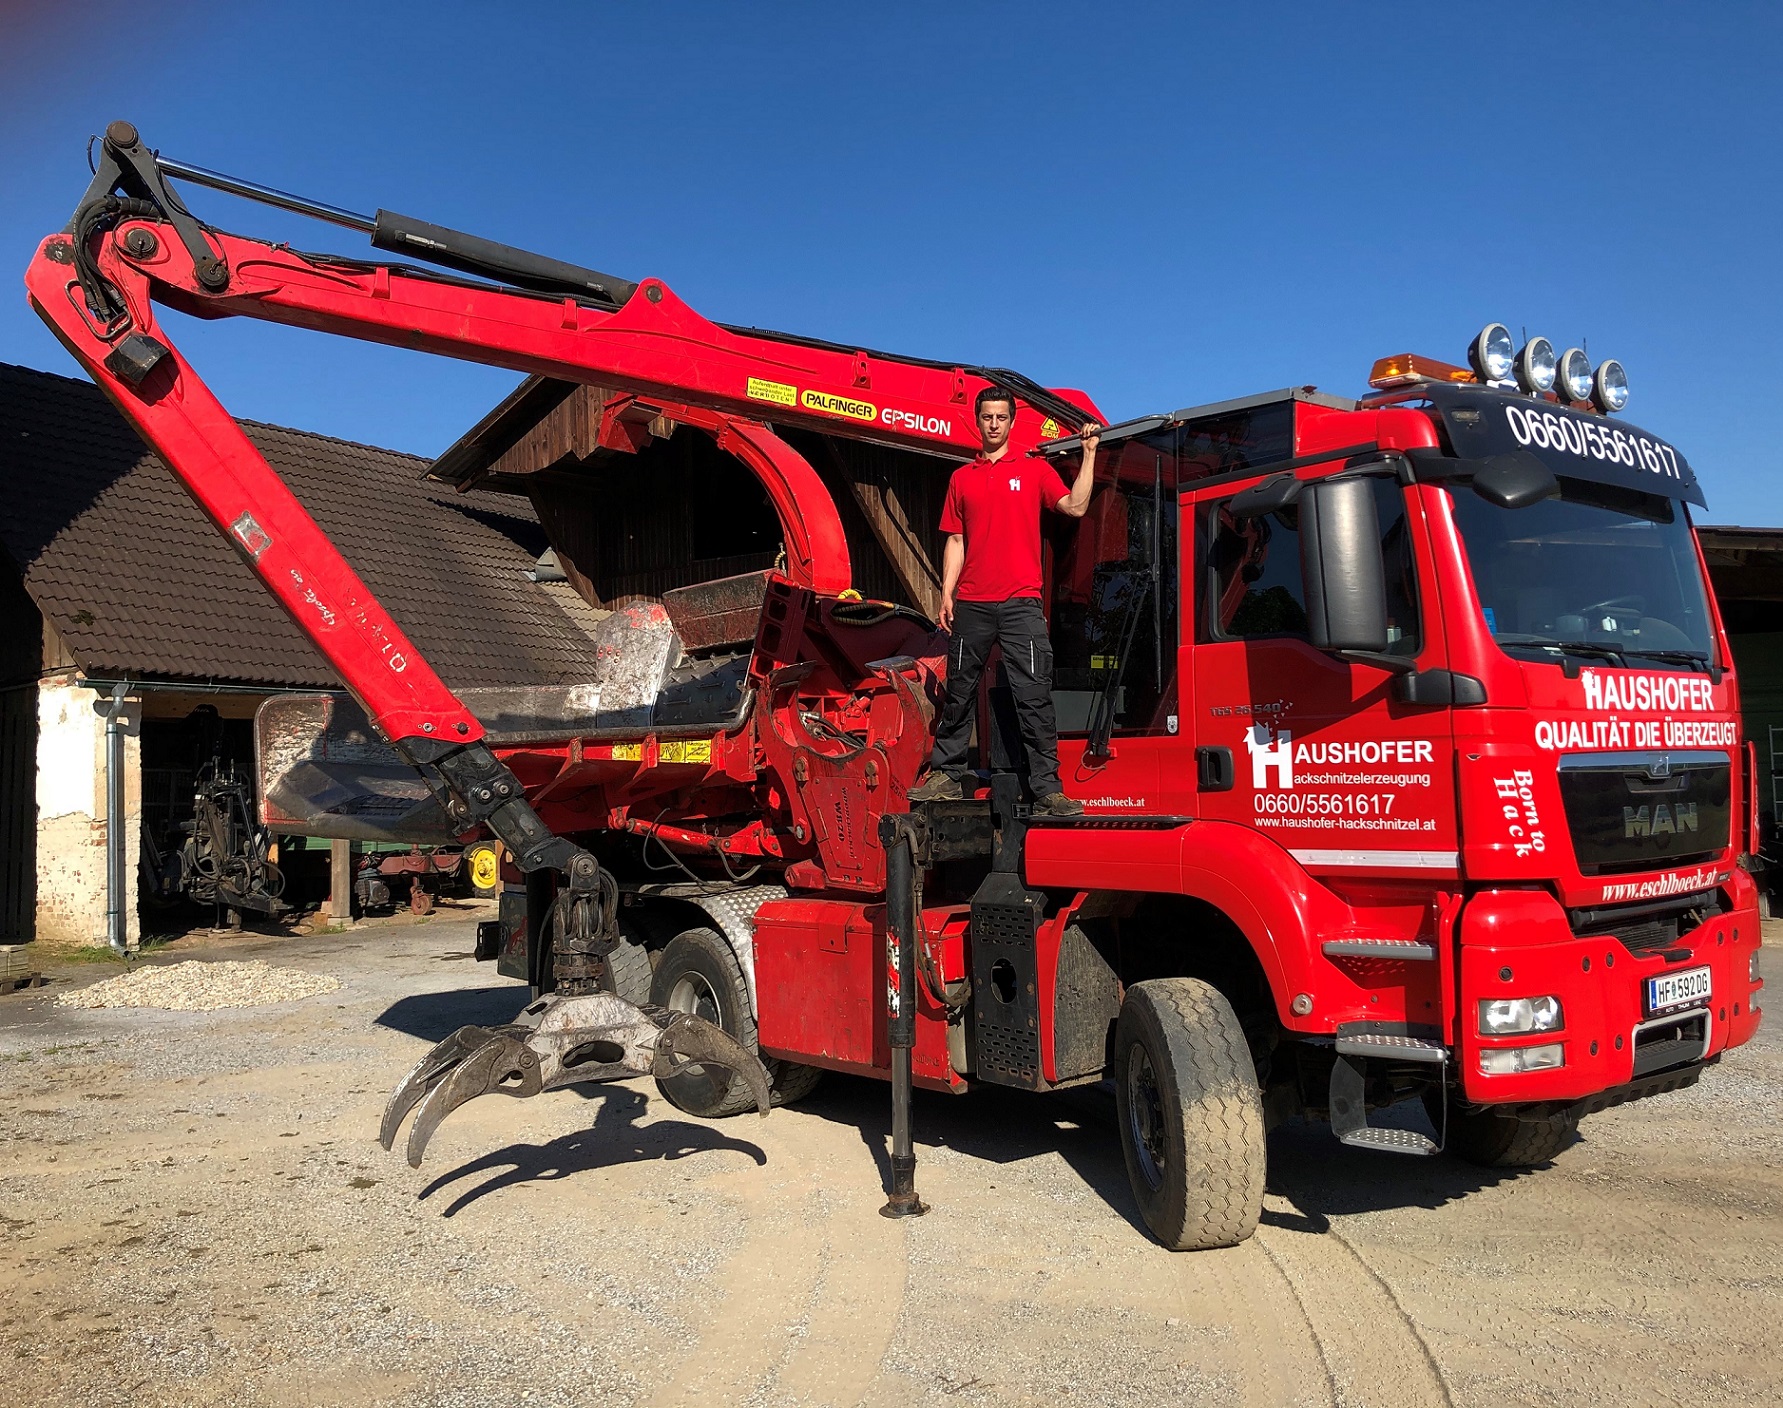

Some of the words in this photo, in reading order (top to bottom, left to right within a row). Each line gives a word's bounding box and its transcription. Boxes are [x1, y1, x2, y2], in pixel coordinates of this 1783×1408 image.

[806, 393, 873, 417] PALFINGER
[881, 408, 951, 436] EPSILON
[1505, 406, 1681, 479] 0660/5561617
[1582, 669, 1714, 711] HAUSHOFER
[1210, 706, 1232, 716] TGS
[1534, 716, 1631, 750] QUALITÄT
[1634, 721, 1661, 747] DIE
[1664, 715, 1737, 746] ÜBERZEUGT
[1294, 771, 1431, 787] ackschnitzelerzeugung
[1253, 793, 1396, 815] 0660/5561617
[1513, 769, 1540, 826] Born
[1530, 830, 1546, 852] to
[1254, 816, 1436, 831] www.haushofer-hackschnitzel.at
[1623, 802, 1698, 838] MAN
[1602, 866, 1718, 901] www.eschlboeck.at
[1658, 981, 1671, 1003] HF
